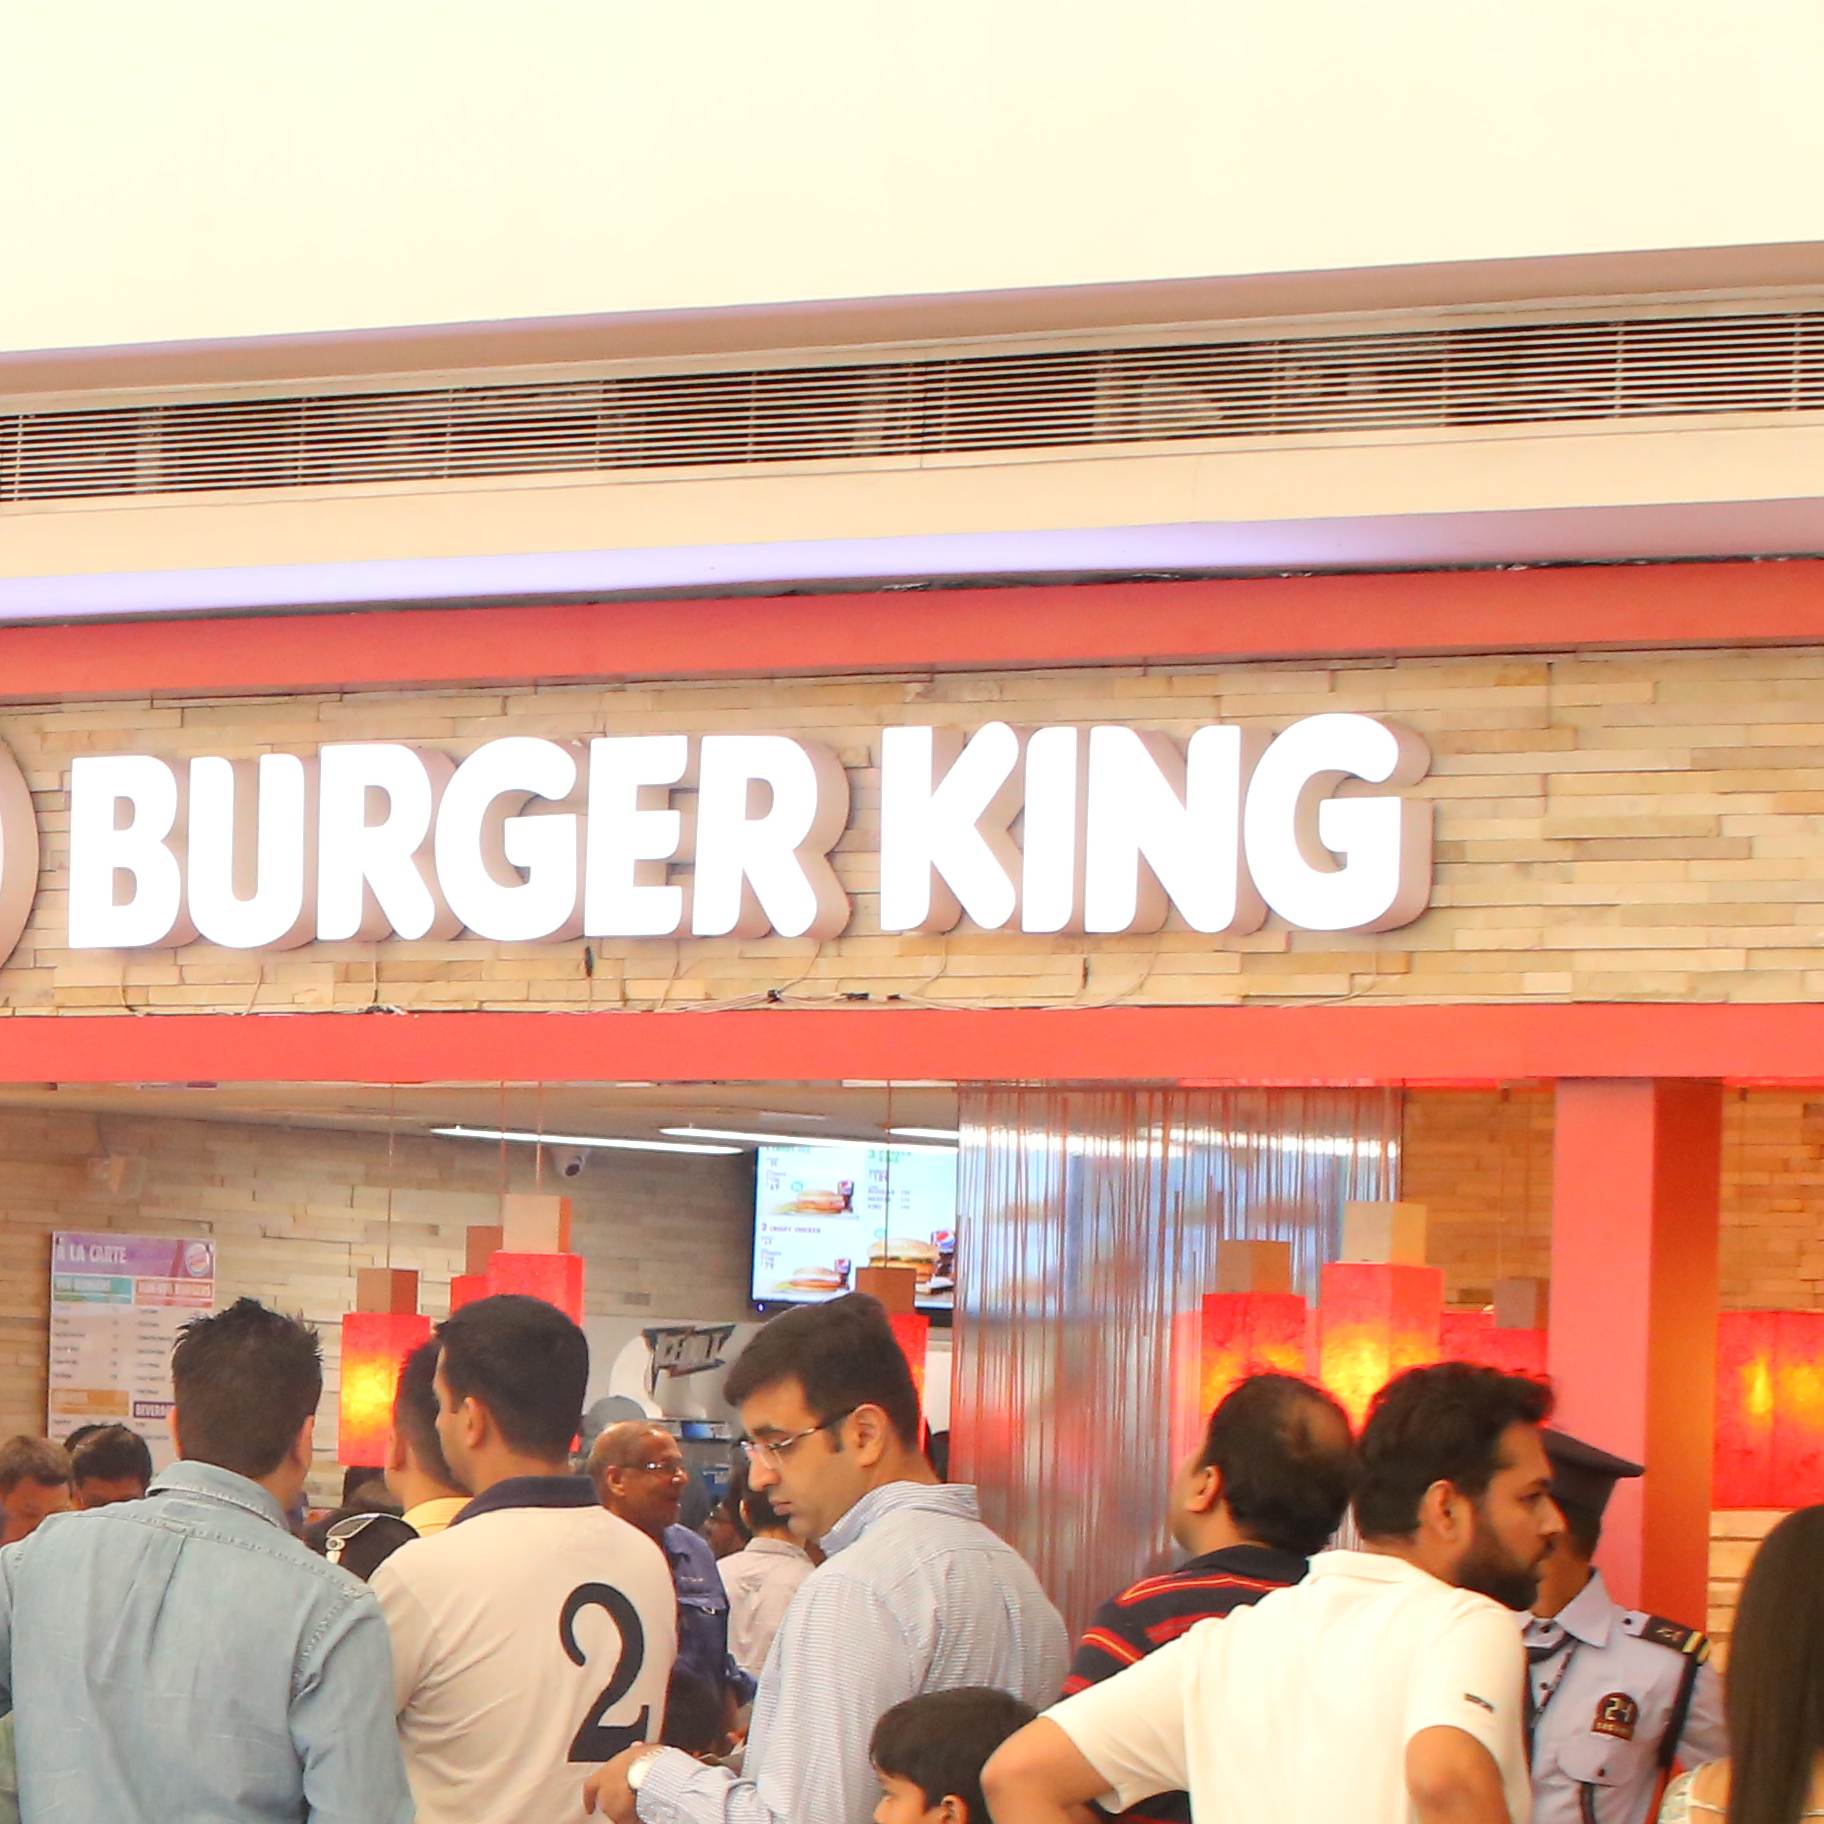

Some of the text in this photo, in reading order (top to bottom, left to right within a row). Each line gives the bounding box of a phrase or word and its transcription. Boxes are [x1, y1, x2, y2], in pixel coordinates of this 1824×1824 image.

[69, 712, 1401, 949] BURGER KING
[559, 1582, 649, 1763] 2
